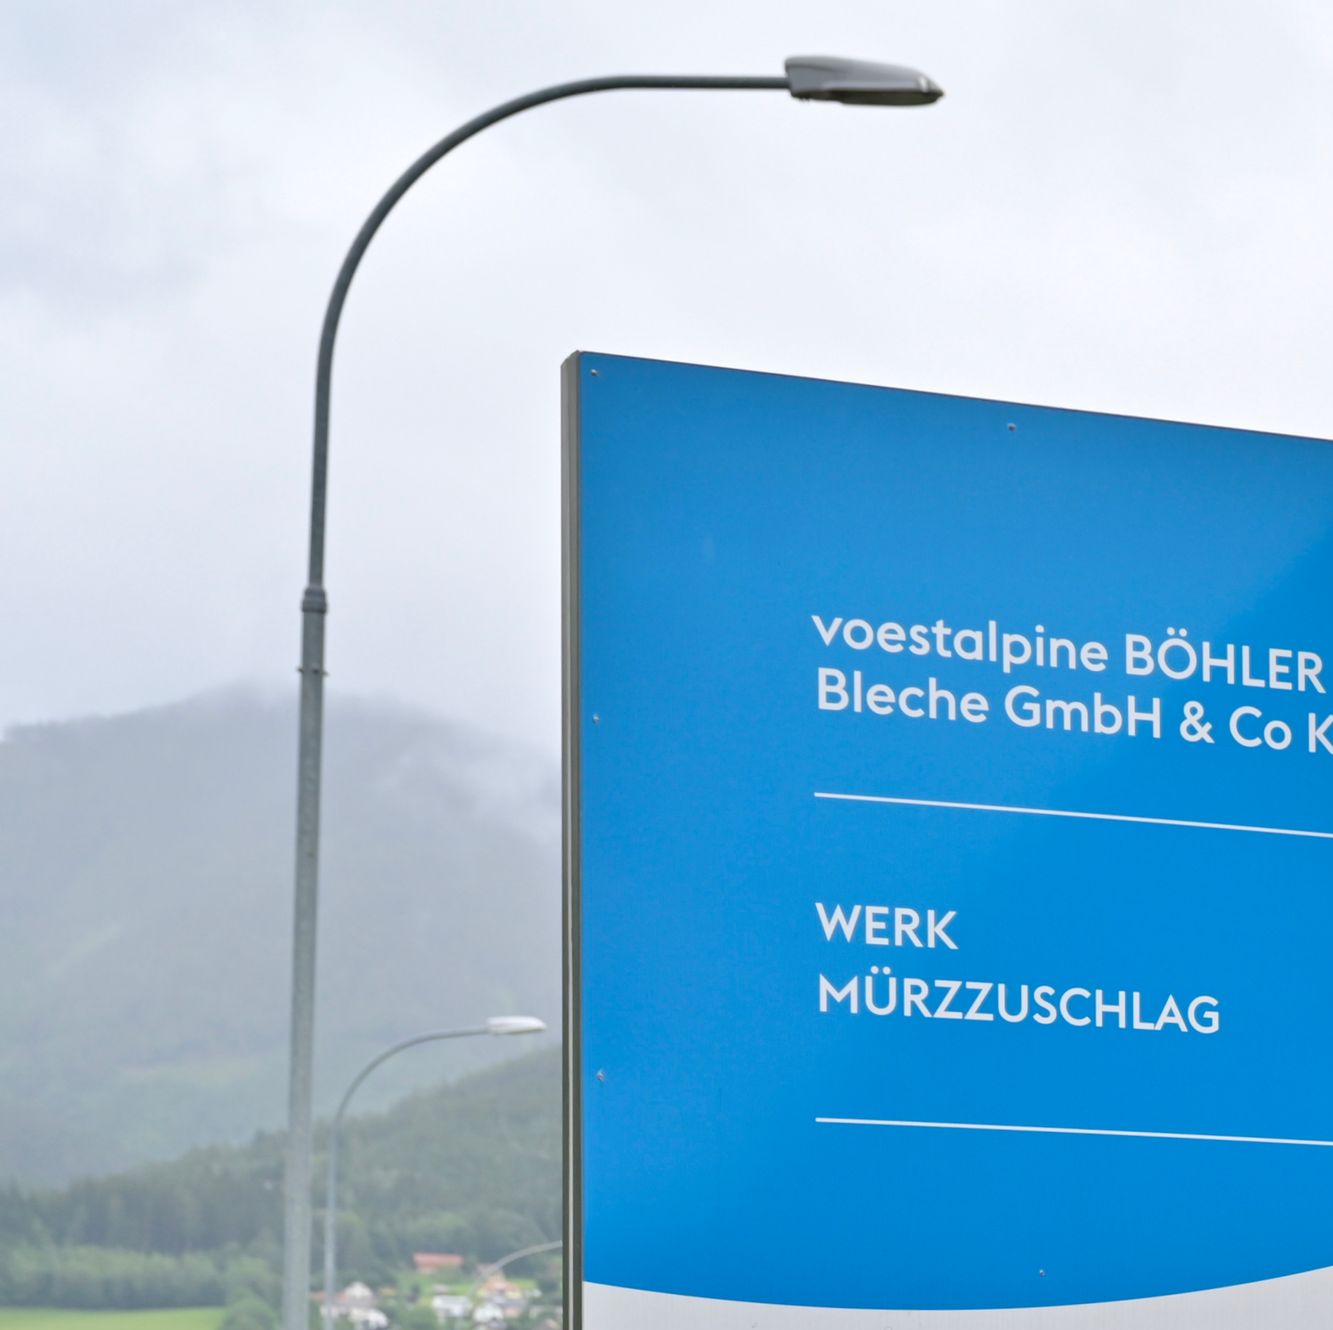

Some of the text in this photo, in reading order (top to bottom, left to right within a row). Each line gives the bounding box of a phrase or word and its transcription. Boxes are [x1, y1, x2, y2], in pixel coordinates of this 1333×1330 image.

[811, 615, 1326, 694] voestalpine BÖHLER
[818, 667, 990, 724] Bleche
[1004, 684, 1161, 739] GmbH
[1179, 700, 1215, 744] &
[1229, 706, 1292, 750] Co
[815, 902, 958, 950] WERK
[819, 965, 1220, 1034] MÜRZZUSCHLAG
